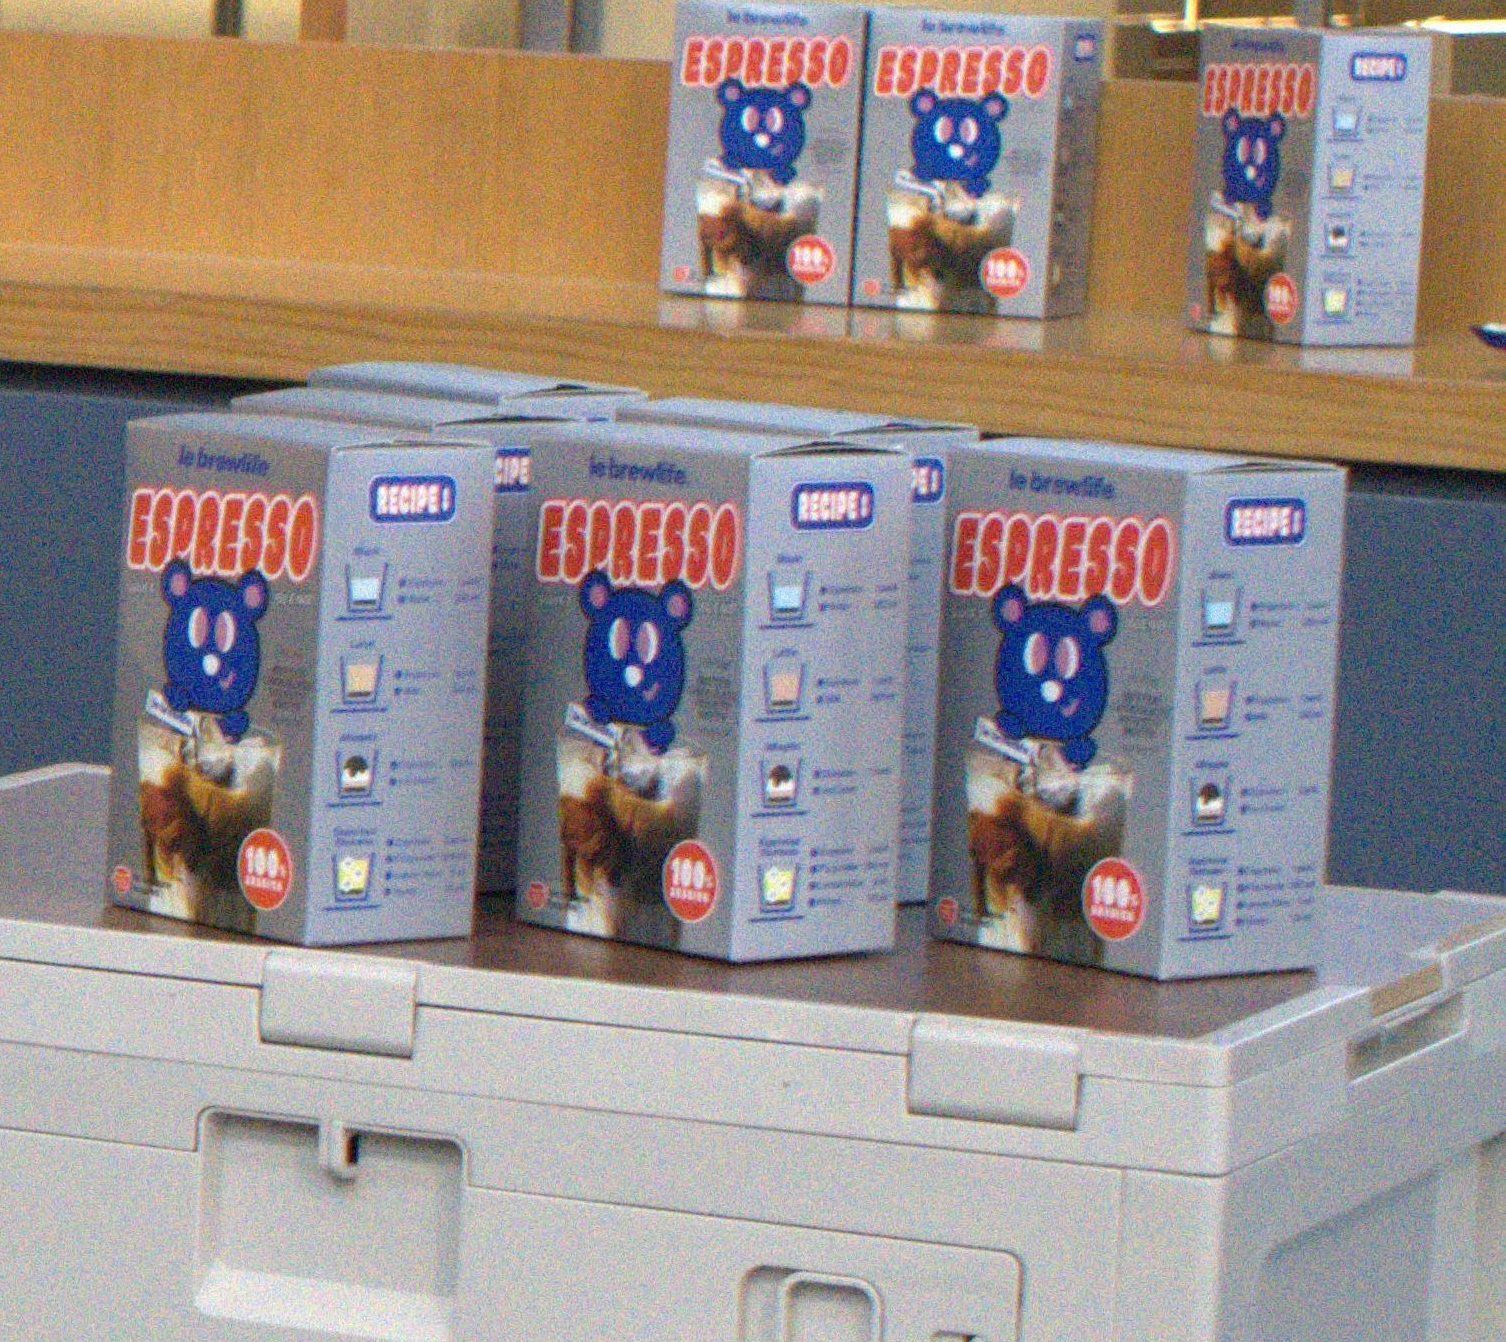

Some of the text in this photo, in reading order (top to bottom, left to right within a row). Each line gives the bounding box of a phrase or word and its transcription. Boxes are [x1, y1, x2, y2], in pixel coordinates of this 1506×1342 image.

[682, 34, 853, 90] ESPRESSO
[874, 44, 1055, 99] ESPRESSO
[1203, 62, 1318, 119] ESPRESSO
[127, 487, 319, 584] ESPRESSO
[536, 499, 739, 591] ESPRESSO
[950, 512, 1174, 607] ESPRESSO
